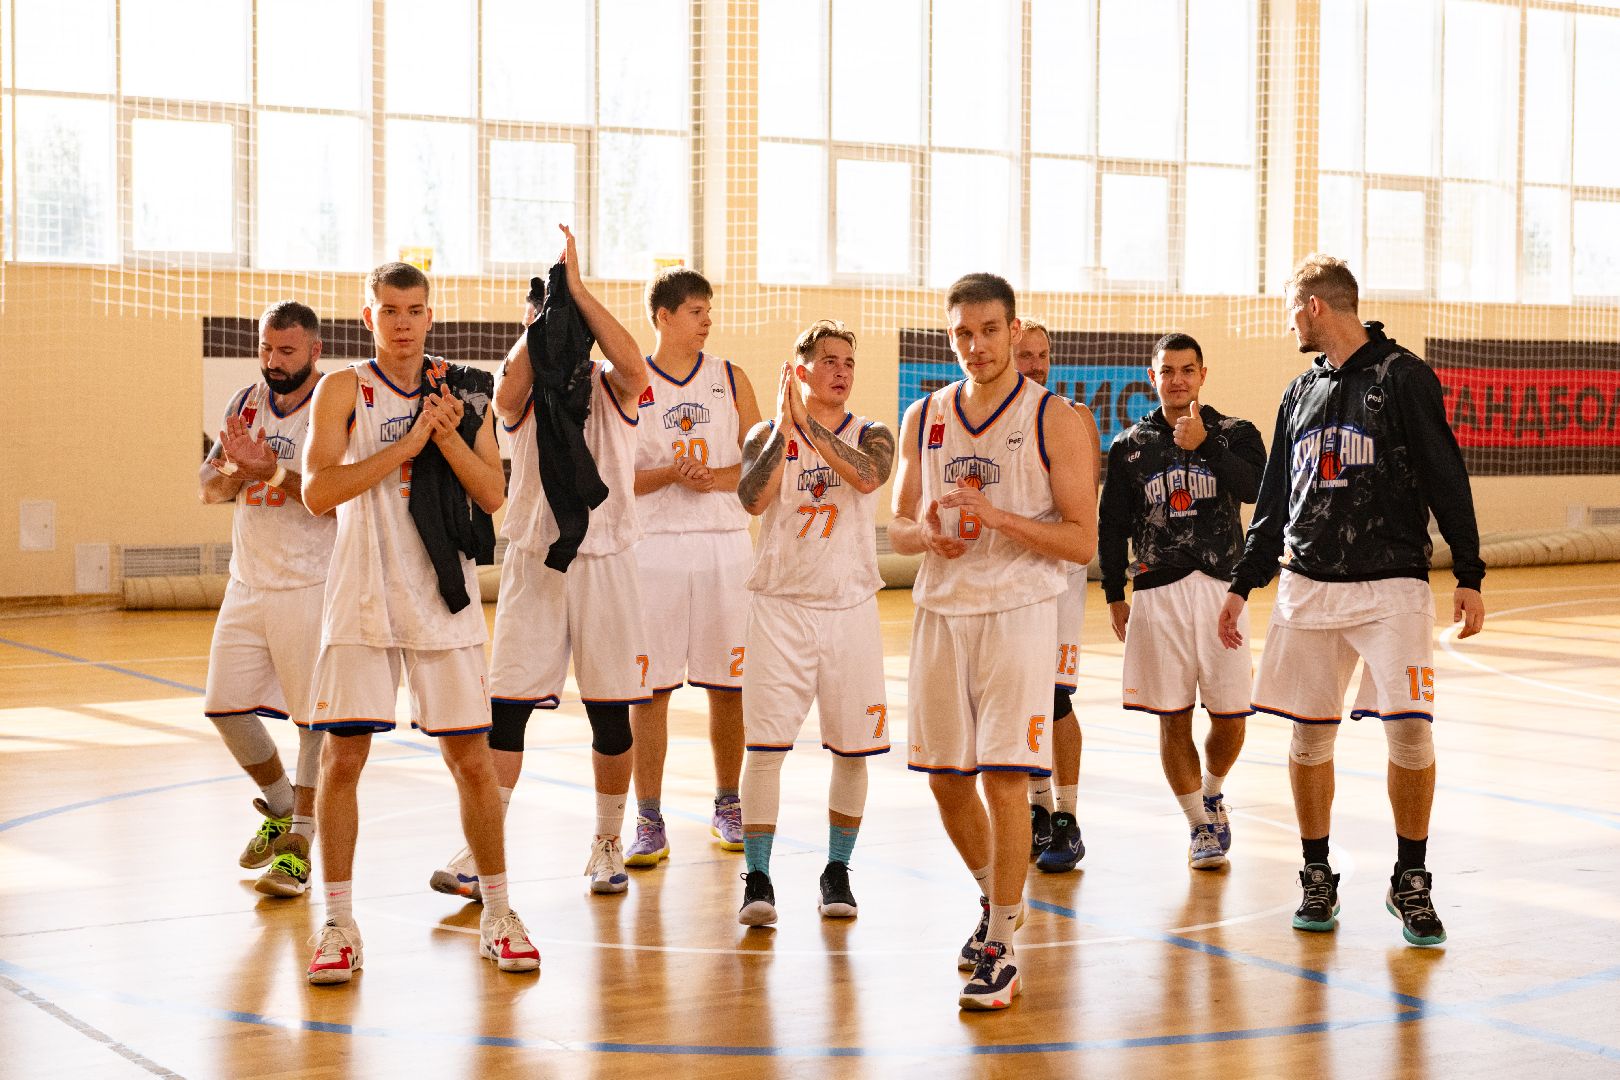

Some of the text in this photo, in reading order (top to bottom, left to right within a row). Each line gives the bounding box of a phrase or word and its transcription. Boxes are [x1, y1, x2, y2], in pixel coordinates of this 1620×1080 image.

[672, 438, 709, 466] 20
[797, 504, 839, 538] 77
[958, 507, 983, 541] 6
[729, 646, 746, 678] 2
[1056, 643, 1079, 676] 13
[1405, 665, 1435, 702] 15
[865, 703, 887, 739] 7
